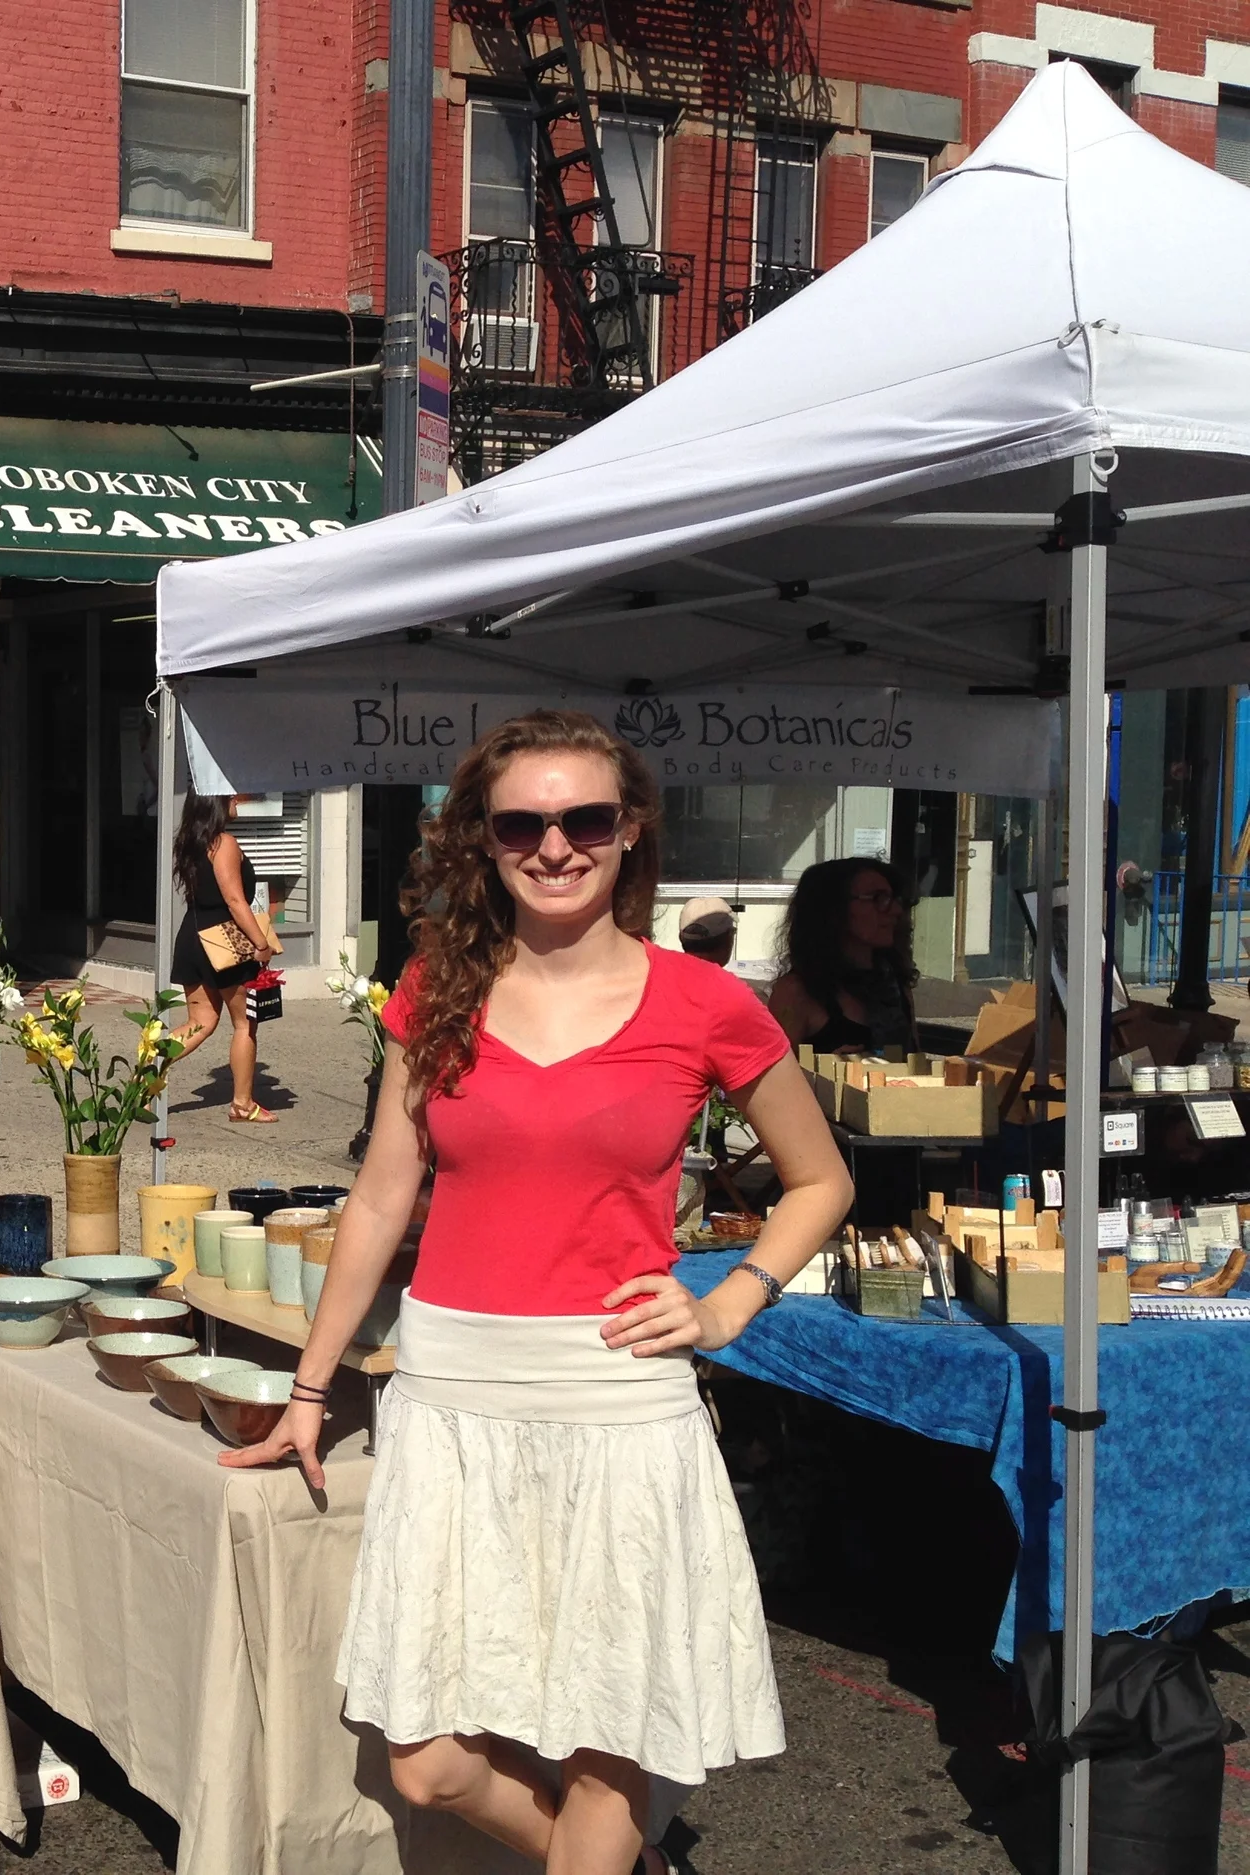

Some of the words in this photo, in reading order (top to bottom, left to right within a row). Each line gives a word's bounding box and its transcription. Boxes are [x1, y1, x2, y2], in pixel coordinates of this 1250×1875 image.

[420, 443, 431, 460] BUS
[432, 447, 446, 464] STOP
[206, 477, 312, 505] CITY
[352, 681, 456, 747] Blue
[698, 690, 913, 748] Botanicals
[292, 751, 456, 777] Handcraf
[664, 751, 743, 780] Body
[768, 754, 833, 774] Care
[852, 755, 957, 780] Products
[1114, 1121, 1135, 1130] Square
